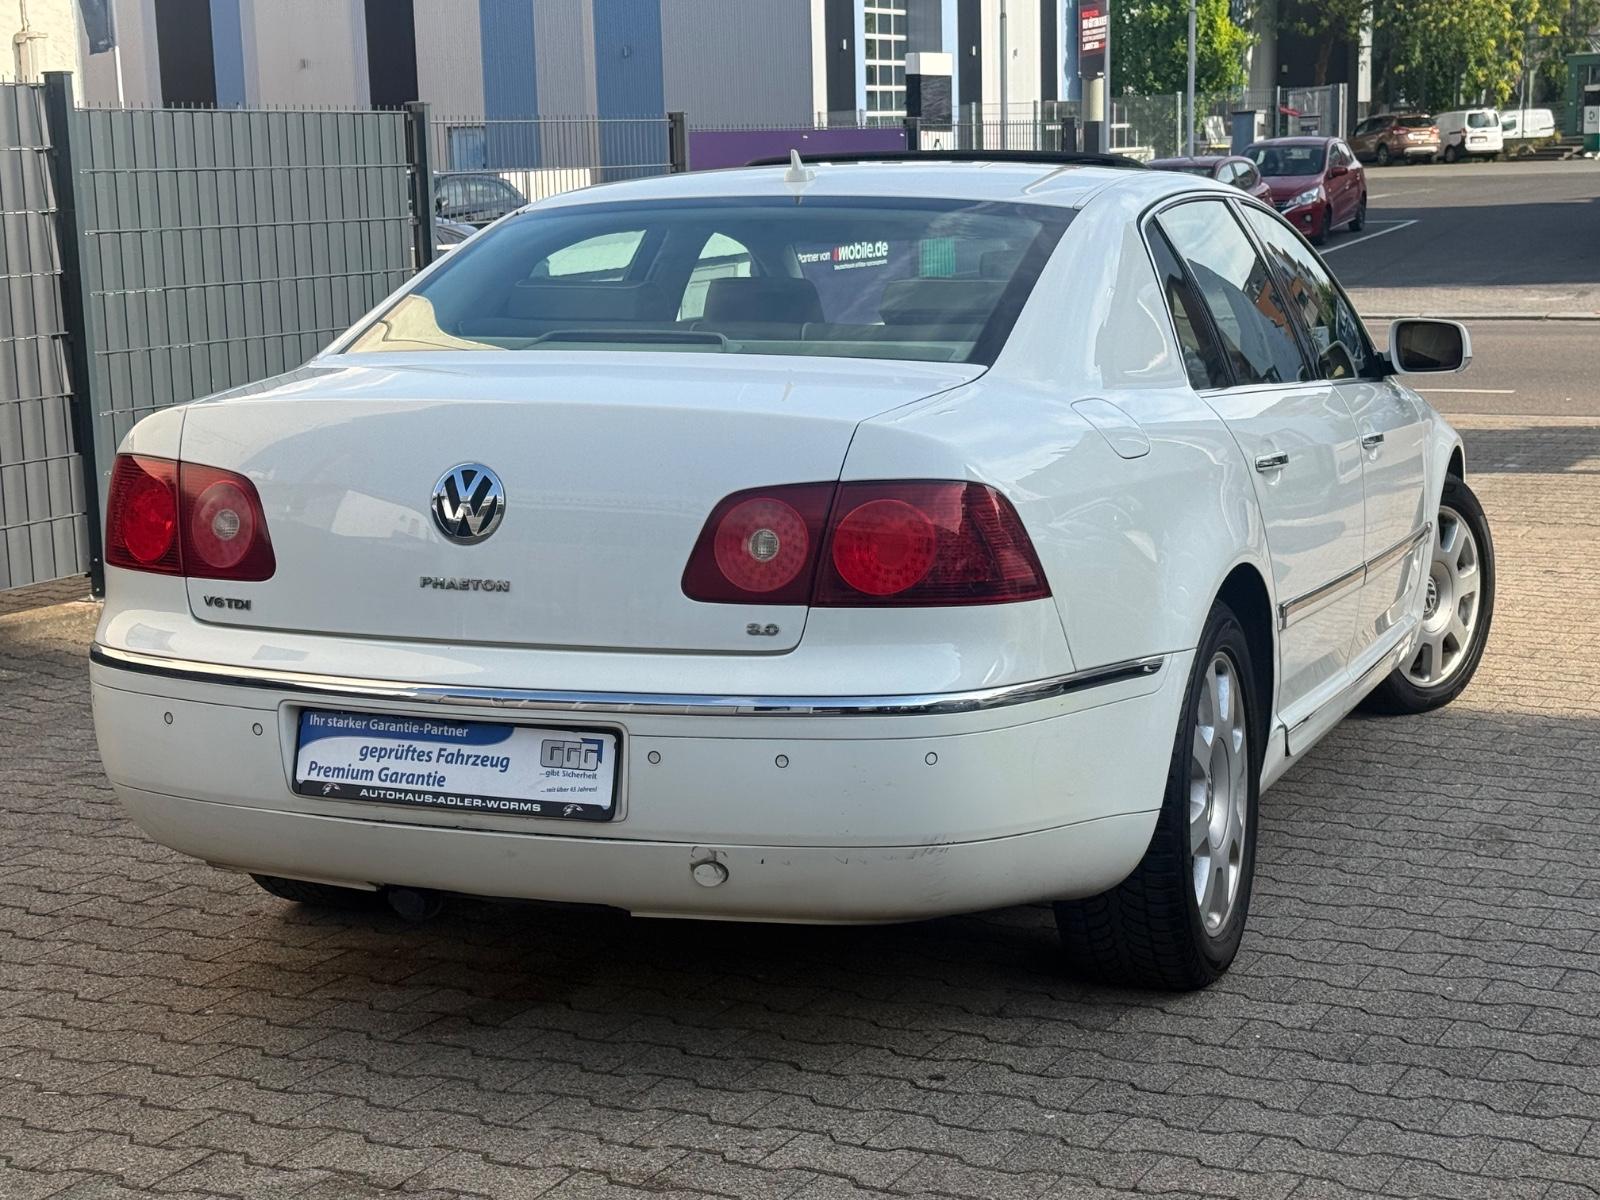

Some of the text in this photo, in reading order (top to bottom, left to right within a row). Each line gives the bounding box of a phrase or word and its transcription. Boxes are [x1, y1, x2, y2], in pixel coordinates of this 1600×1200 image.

[820, 251, 830, 261] von
[838, 241, 889, 262] mobile.de
[420, 576, 511, 592] PHAETON
[746, 623, 780, 637] 3.0
[309, 714, 469, 738] Ihr starker Garantie-Partner
[358, 744, 511, 773] geprüftes Fahrzeug
[307, 760, 447, 788] Premium Garantie
[561, 769, 598, 780] Sicherheit
[359, 789, 542, 812] AUTOHAUS-ADLER-WORMS
